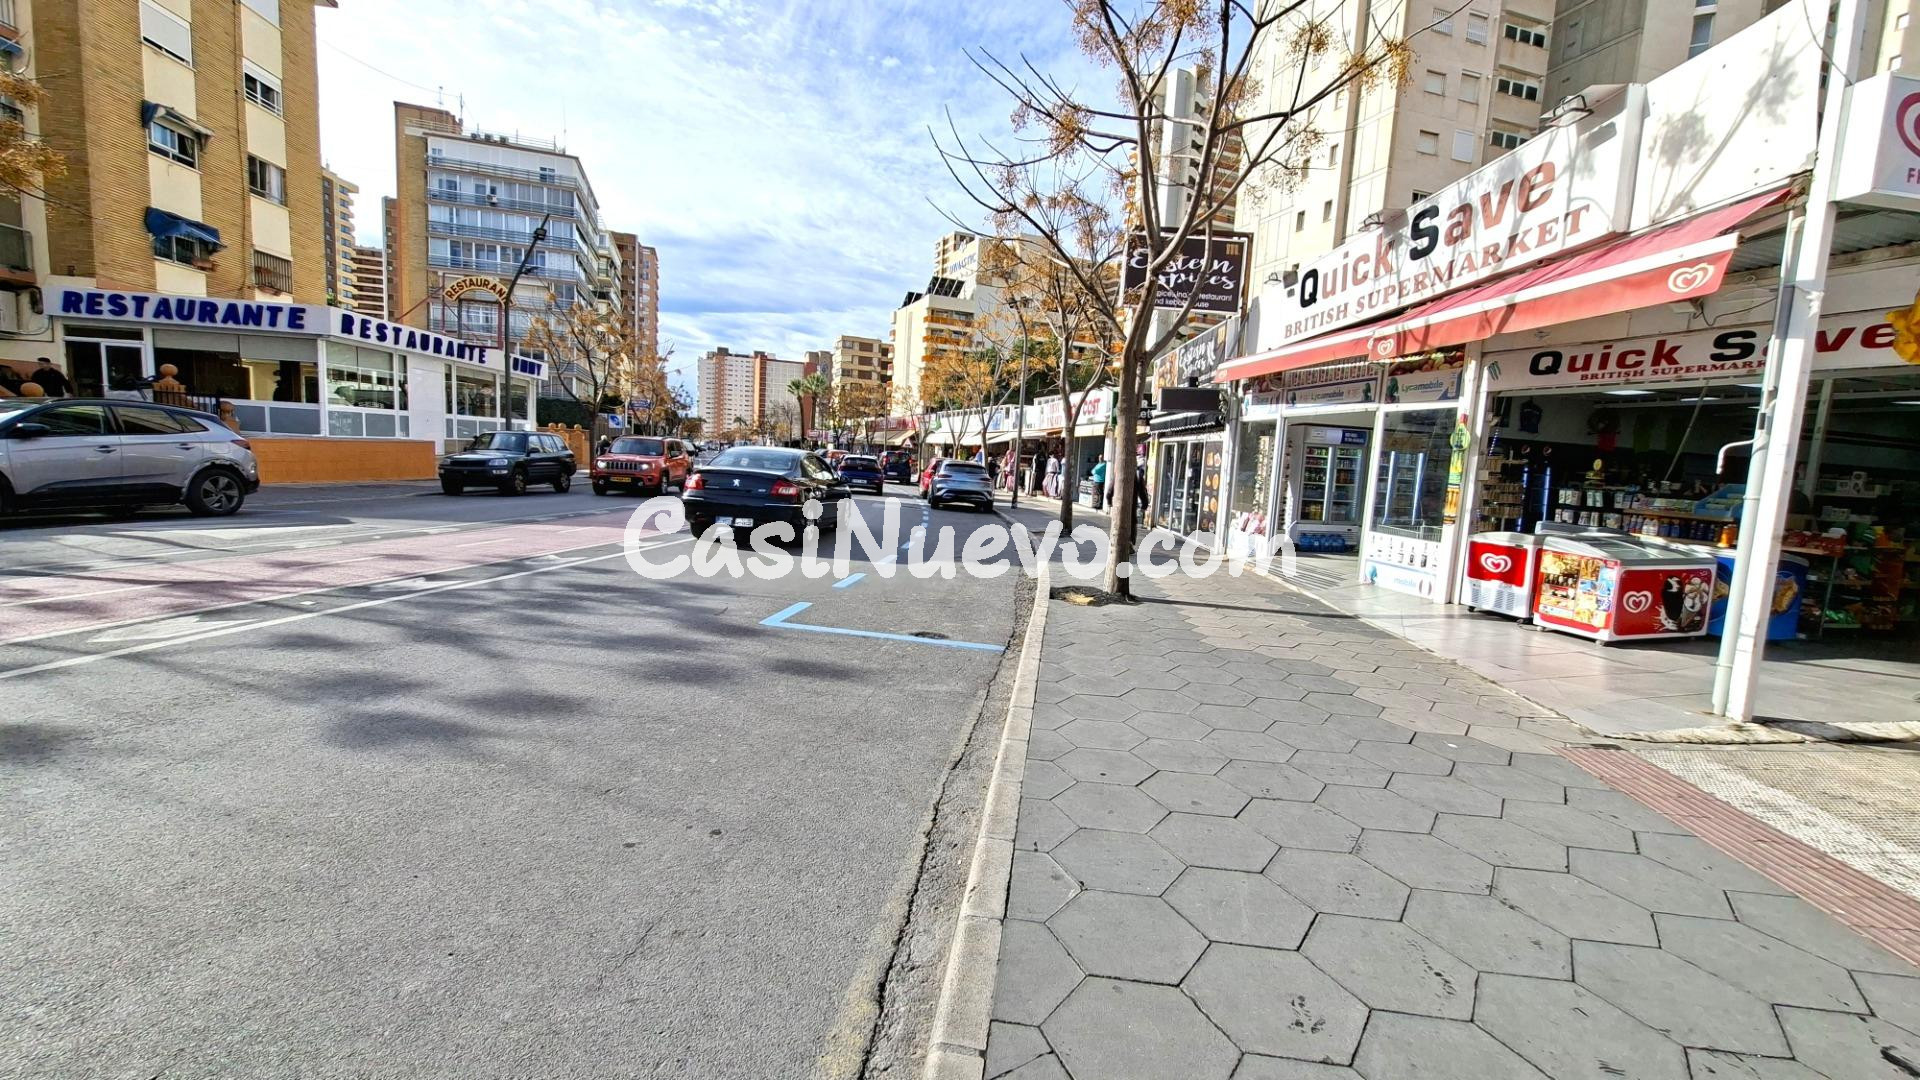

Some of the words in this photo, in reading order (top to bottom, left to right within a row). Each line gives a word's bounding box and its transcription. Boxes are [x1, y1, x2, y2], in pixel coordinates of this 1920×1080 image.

[1299, 234, 1395, 308] Quick
[1409, 160, 1556, 261] Save
[444, 278, 517, 308] RESTAURAN
[1284, 294, 1348, 339] BRITISH
[1357, 205, 1590, 314] SUPERMARKET
[62, 290, 306, 330] RESTAURANTE
[341, 313, 487, 364] RESTAURANTE
[1529, 339, 1682, 376] Quick
[1710, 322, 1896, 362] Sve
[1580, 369, 1646, 381] BRITISH
[1651, 359, 1767, 378] SUPERMARK
